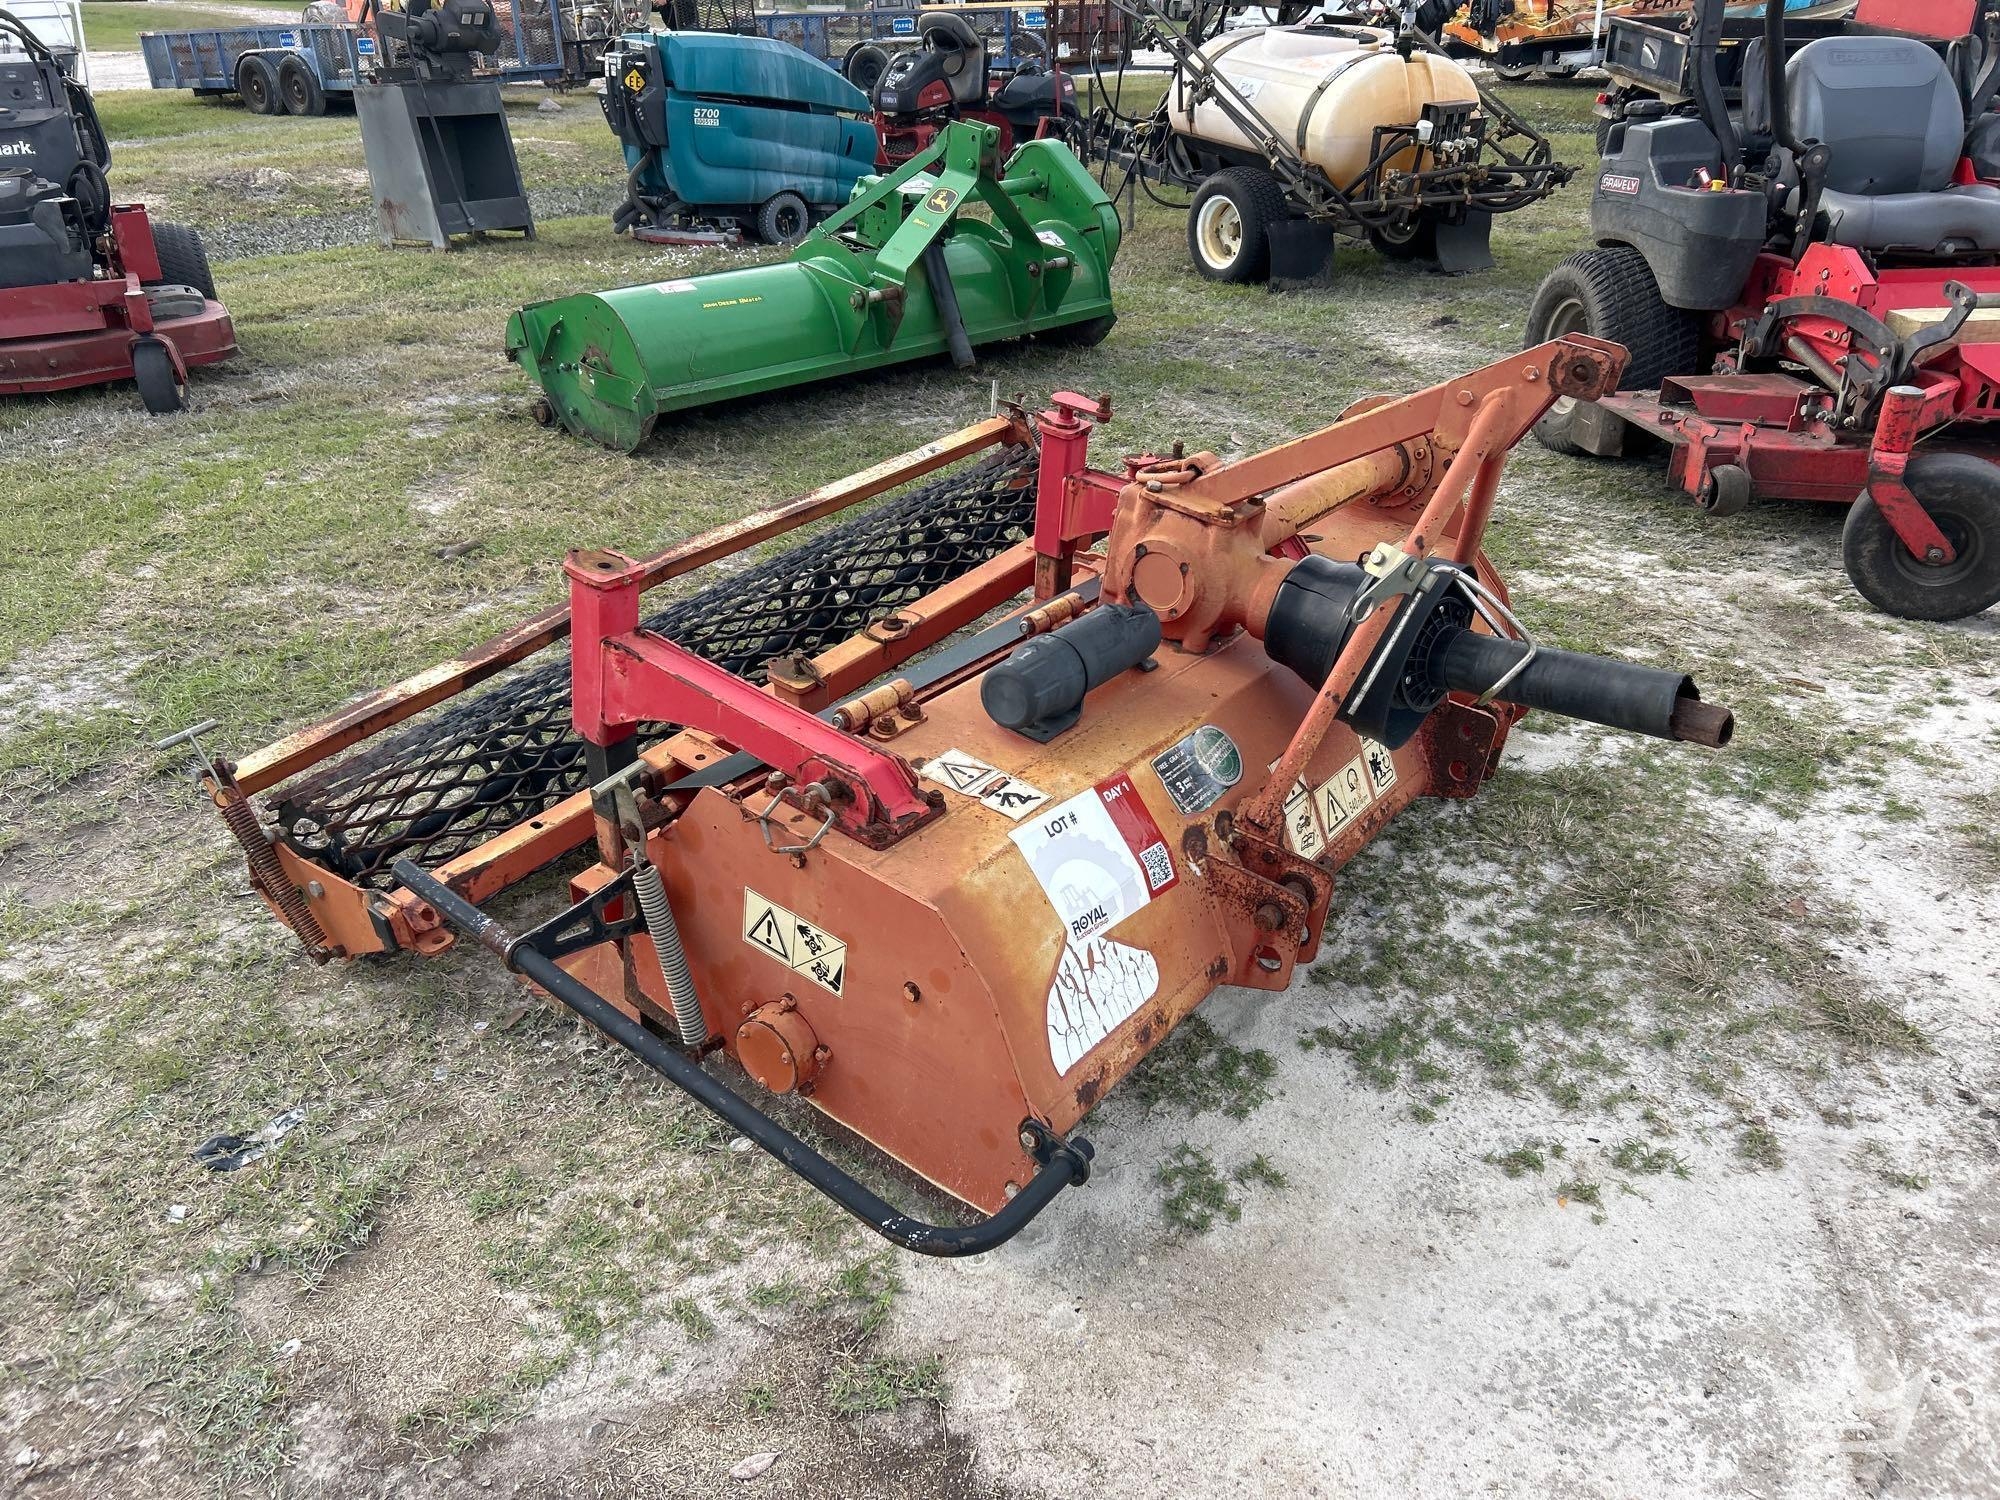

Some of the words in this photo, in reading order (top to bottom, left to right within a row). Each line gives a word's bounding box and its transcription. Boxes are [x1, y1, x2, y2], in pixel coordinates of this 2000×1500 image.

[694, 108, 719, 118] 5700
[1603, 177, 1638, 191] GRAVELY
[1157, 761, 1168, 771] FREE
[1103, 787, 1122, 803] DAY
[1123, 782, 1130, 792] 1
[1044, 814, 1067, 838] LOT
[1069, 811, 1078, 825] #
[1071, 905, 1108, 936] ROYAL
[1076, 925, 1095, 942] Auction
[1094, 917, 1110, 932] Group
